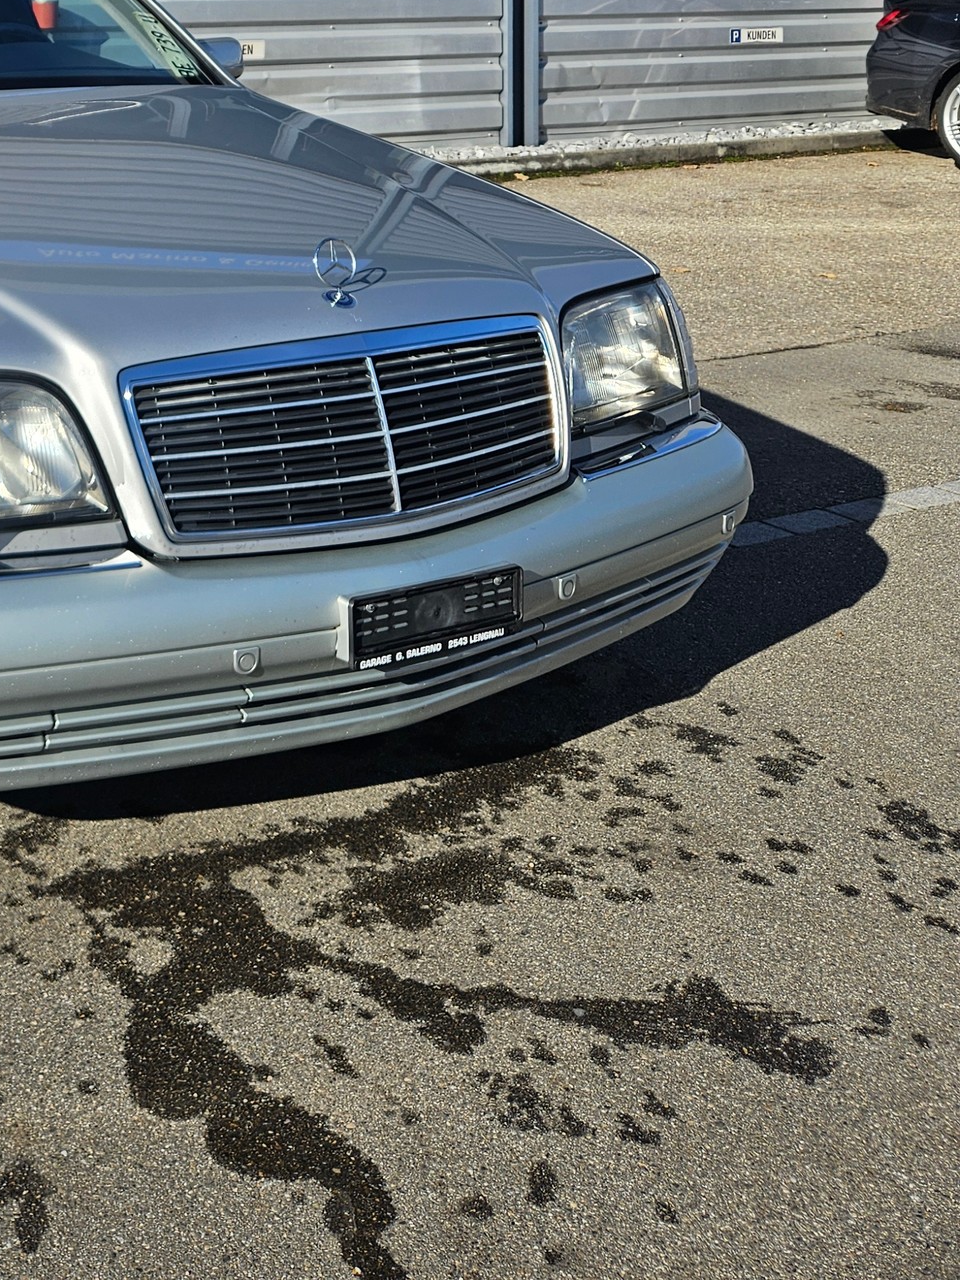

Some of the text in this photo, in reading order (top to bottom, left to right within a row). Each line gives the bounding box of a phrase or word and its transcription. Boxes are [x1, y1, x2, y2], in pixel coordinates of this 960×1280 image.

[747, 30, 776, 40] KUNDEN
[360, 654, 392, 670] GARAGE
[447, 636, 469, 650] 2543
[469, 627, 505, 646] LENGNAU
